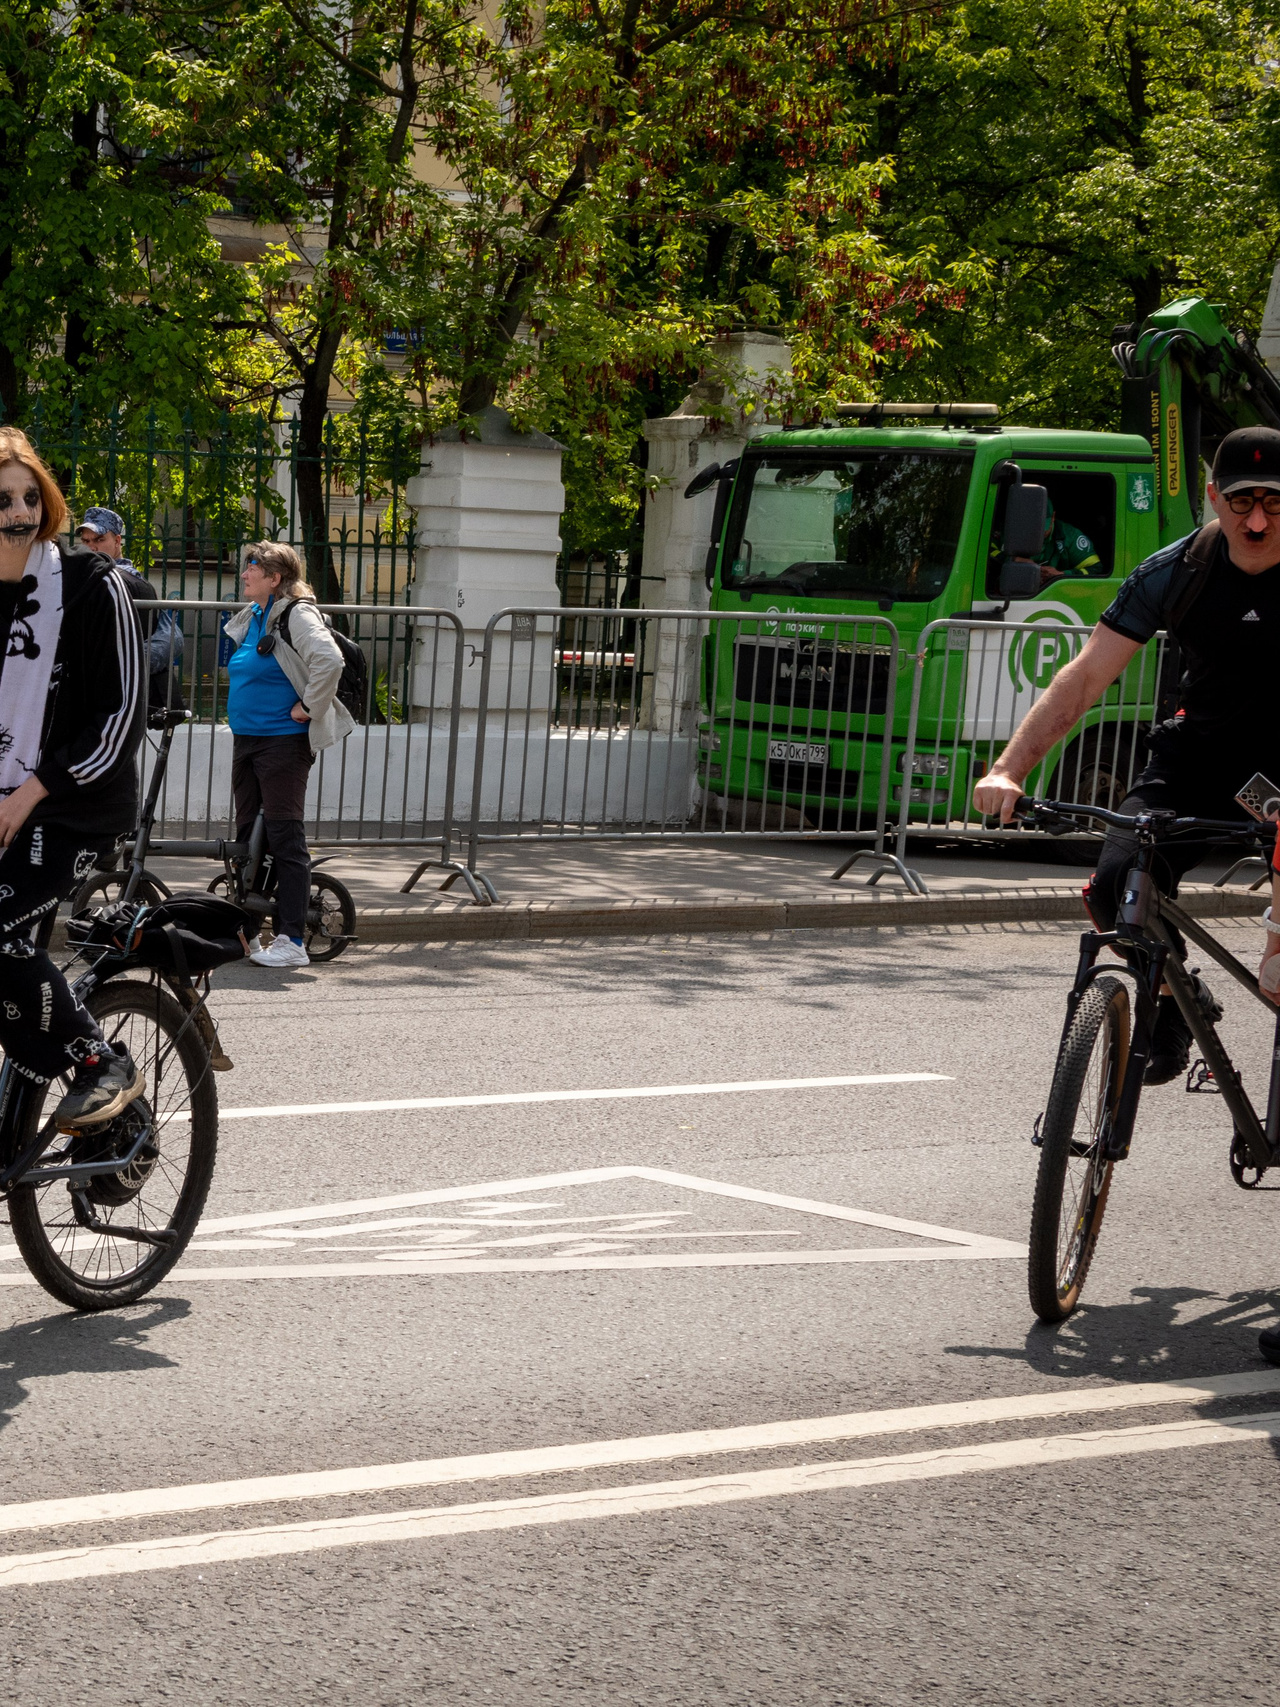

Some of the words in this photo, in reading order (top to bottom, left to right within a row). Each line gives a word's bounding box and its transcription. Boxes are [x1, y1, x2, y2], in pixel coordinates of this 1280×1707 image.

[1168, 408, 1178, 491] PALFINGER
[780, 662, 833, 683] MAN
[30, 831, 43, 866] HELLO
[40, 981, 53, 1014] HELLO
